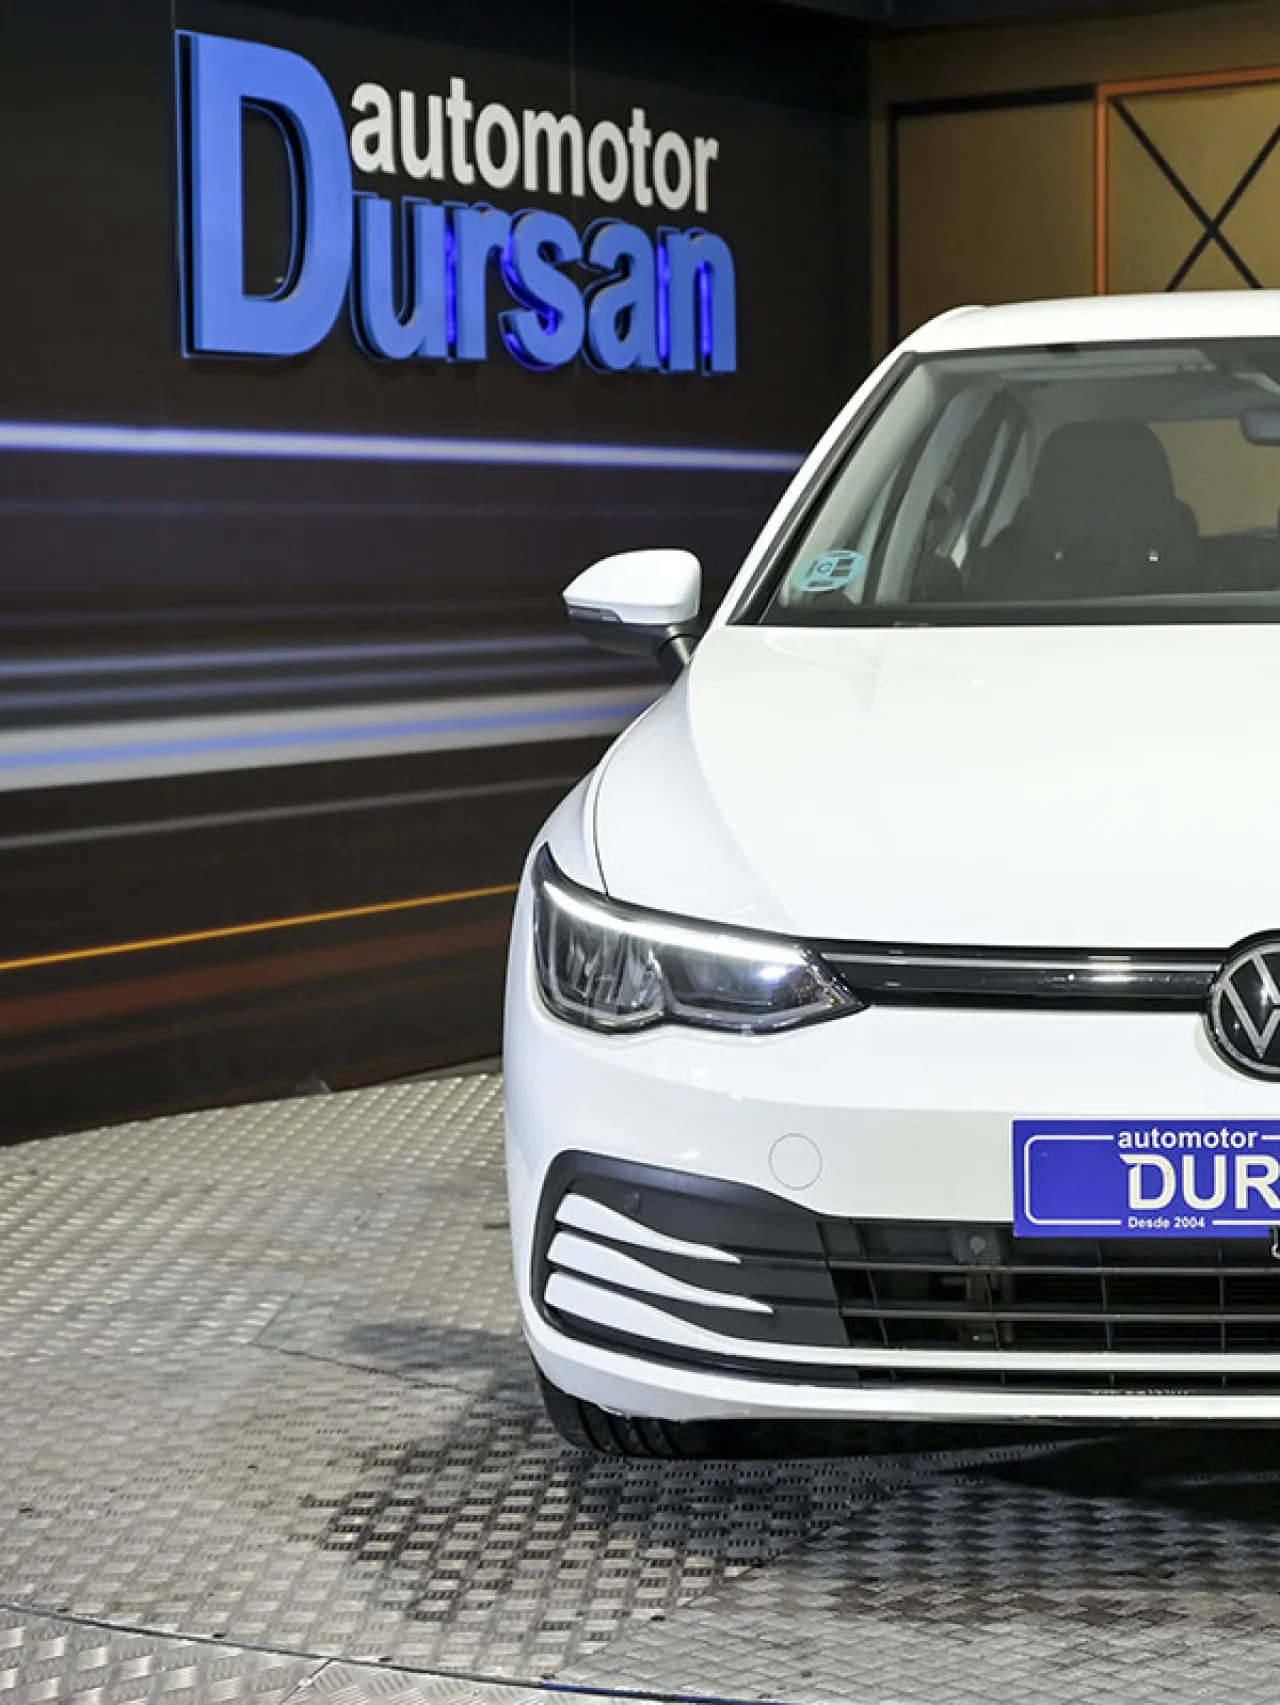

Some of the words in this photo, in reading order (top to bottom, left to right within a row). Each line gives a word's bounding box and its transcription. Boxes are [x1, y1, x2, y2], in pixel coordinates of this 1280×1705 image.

[350, 77, 718, 213] automotor
[174, 28, 738, 376] Dursan
[1117, 1127, 1259, 1150] automotor
[1127, 1216, 1171, 1229] Desde
[1173, 1216, 1206, 1229] 2004
